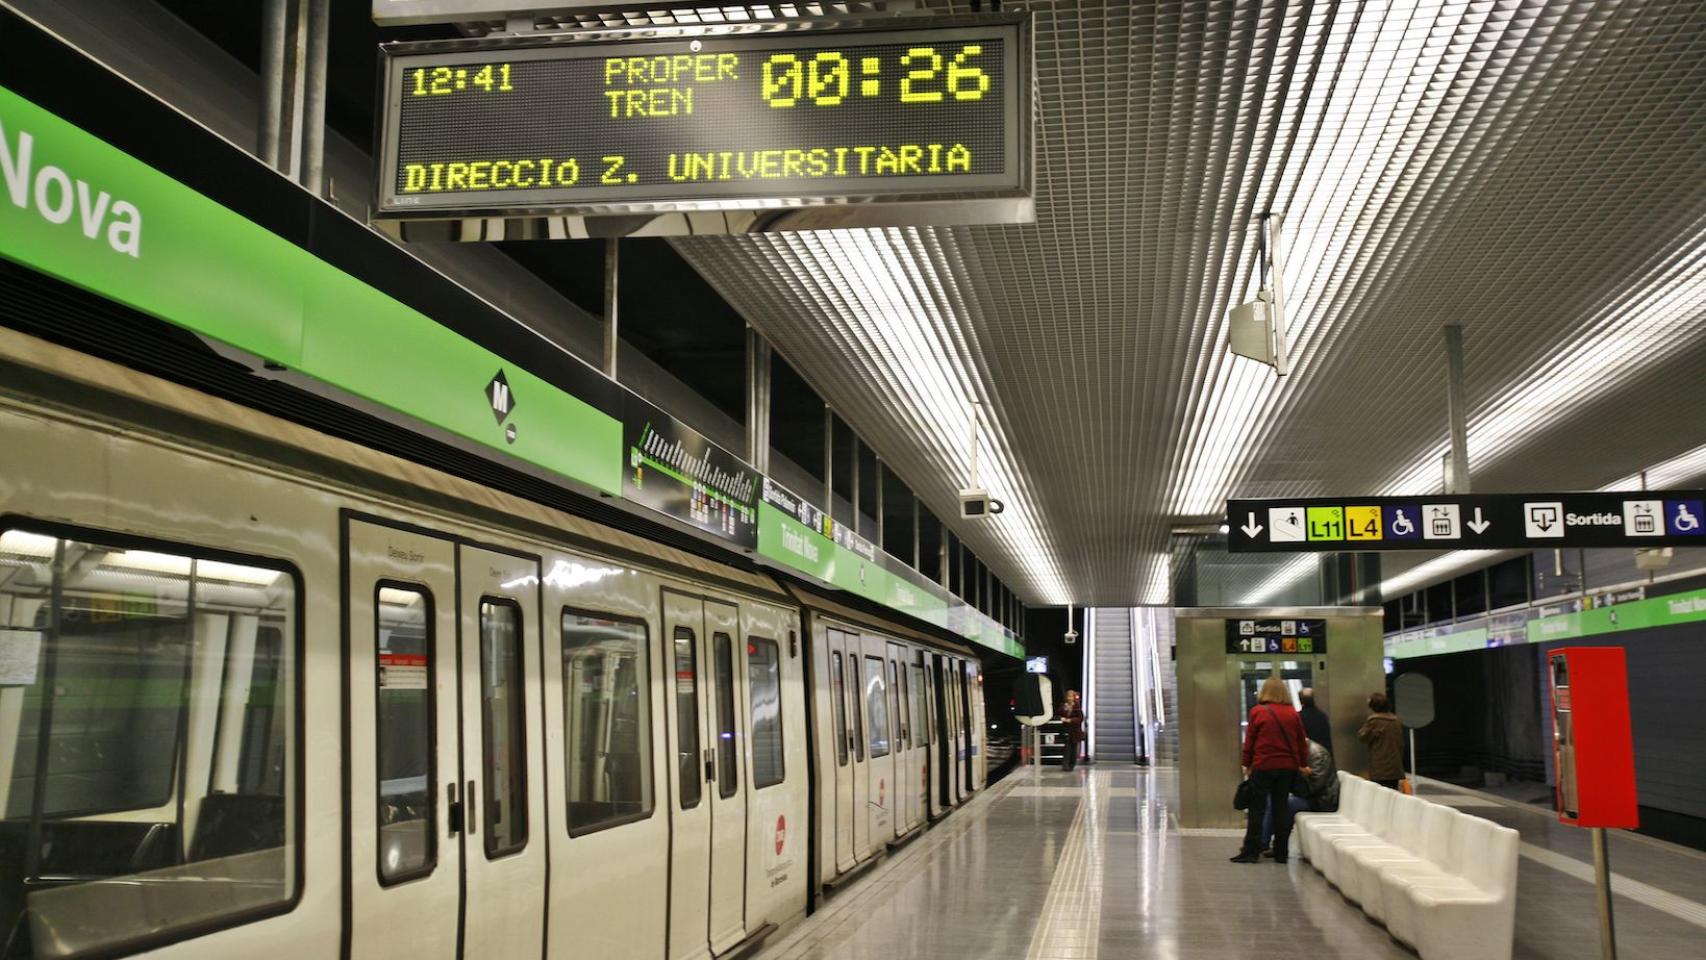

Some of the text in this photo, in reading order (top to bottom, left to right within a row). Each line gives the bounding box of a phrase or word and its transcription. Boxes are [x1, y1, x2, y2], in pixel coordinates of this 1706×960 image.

[413, 64, 513, 95] 12:41
[605, 53, 738, 85] PROPER
[762, 46, 989, 107] 00:26
[604, 87, 693, 118] TREN
[601, 155, 638, 184] Z.
[669, 144, 971, 181] UNIVERSITÀRIA
[0, 116, 142, 258] Nova
[1311, 518, 1378, 537] L11 L4
[1565, 512, 1622, 526] Sortida
